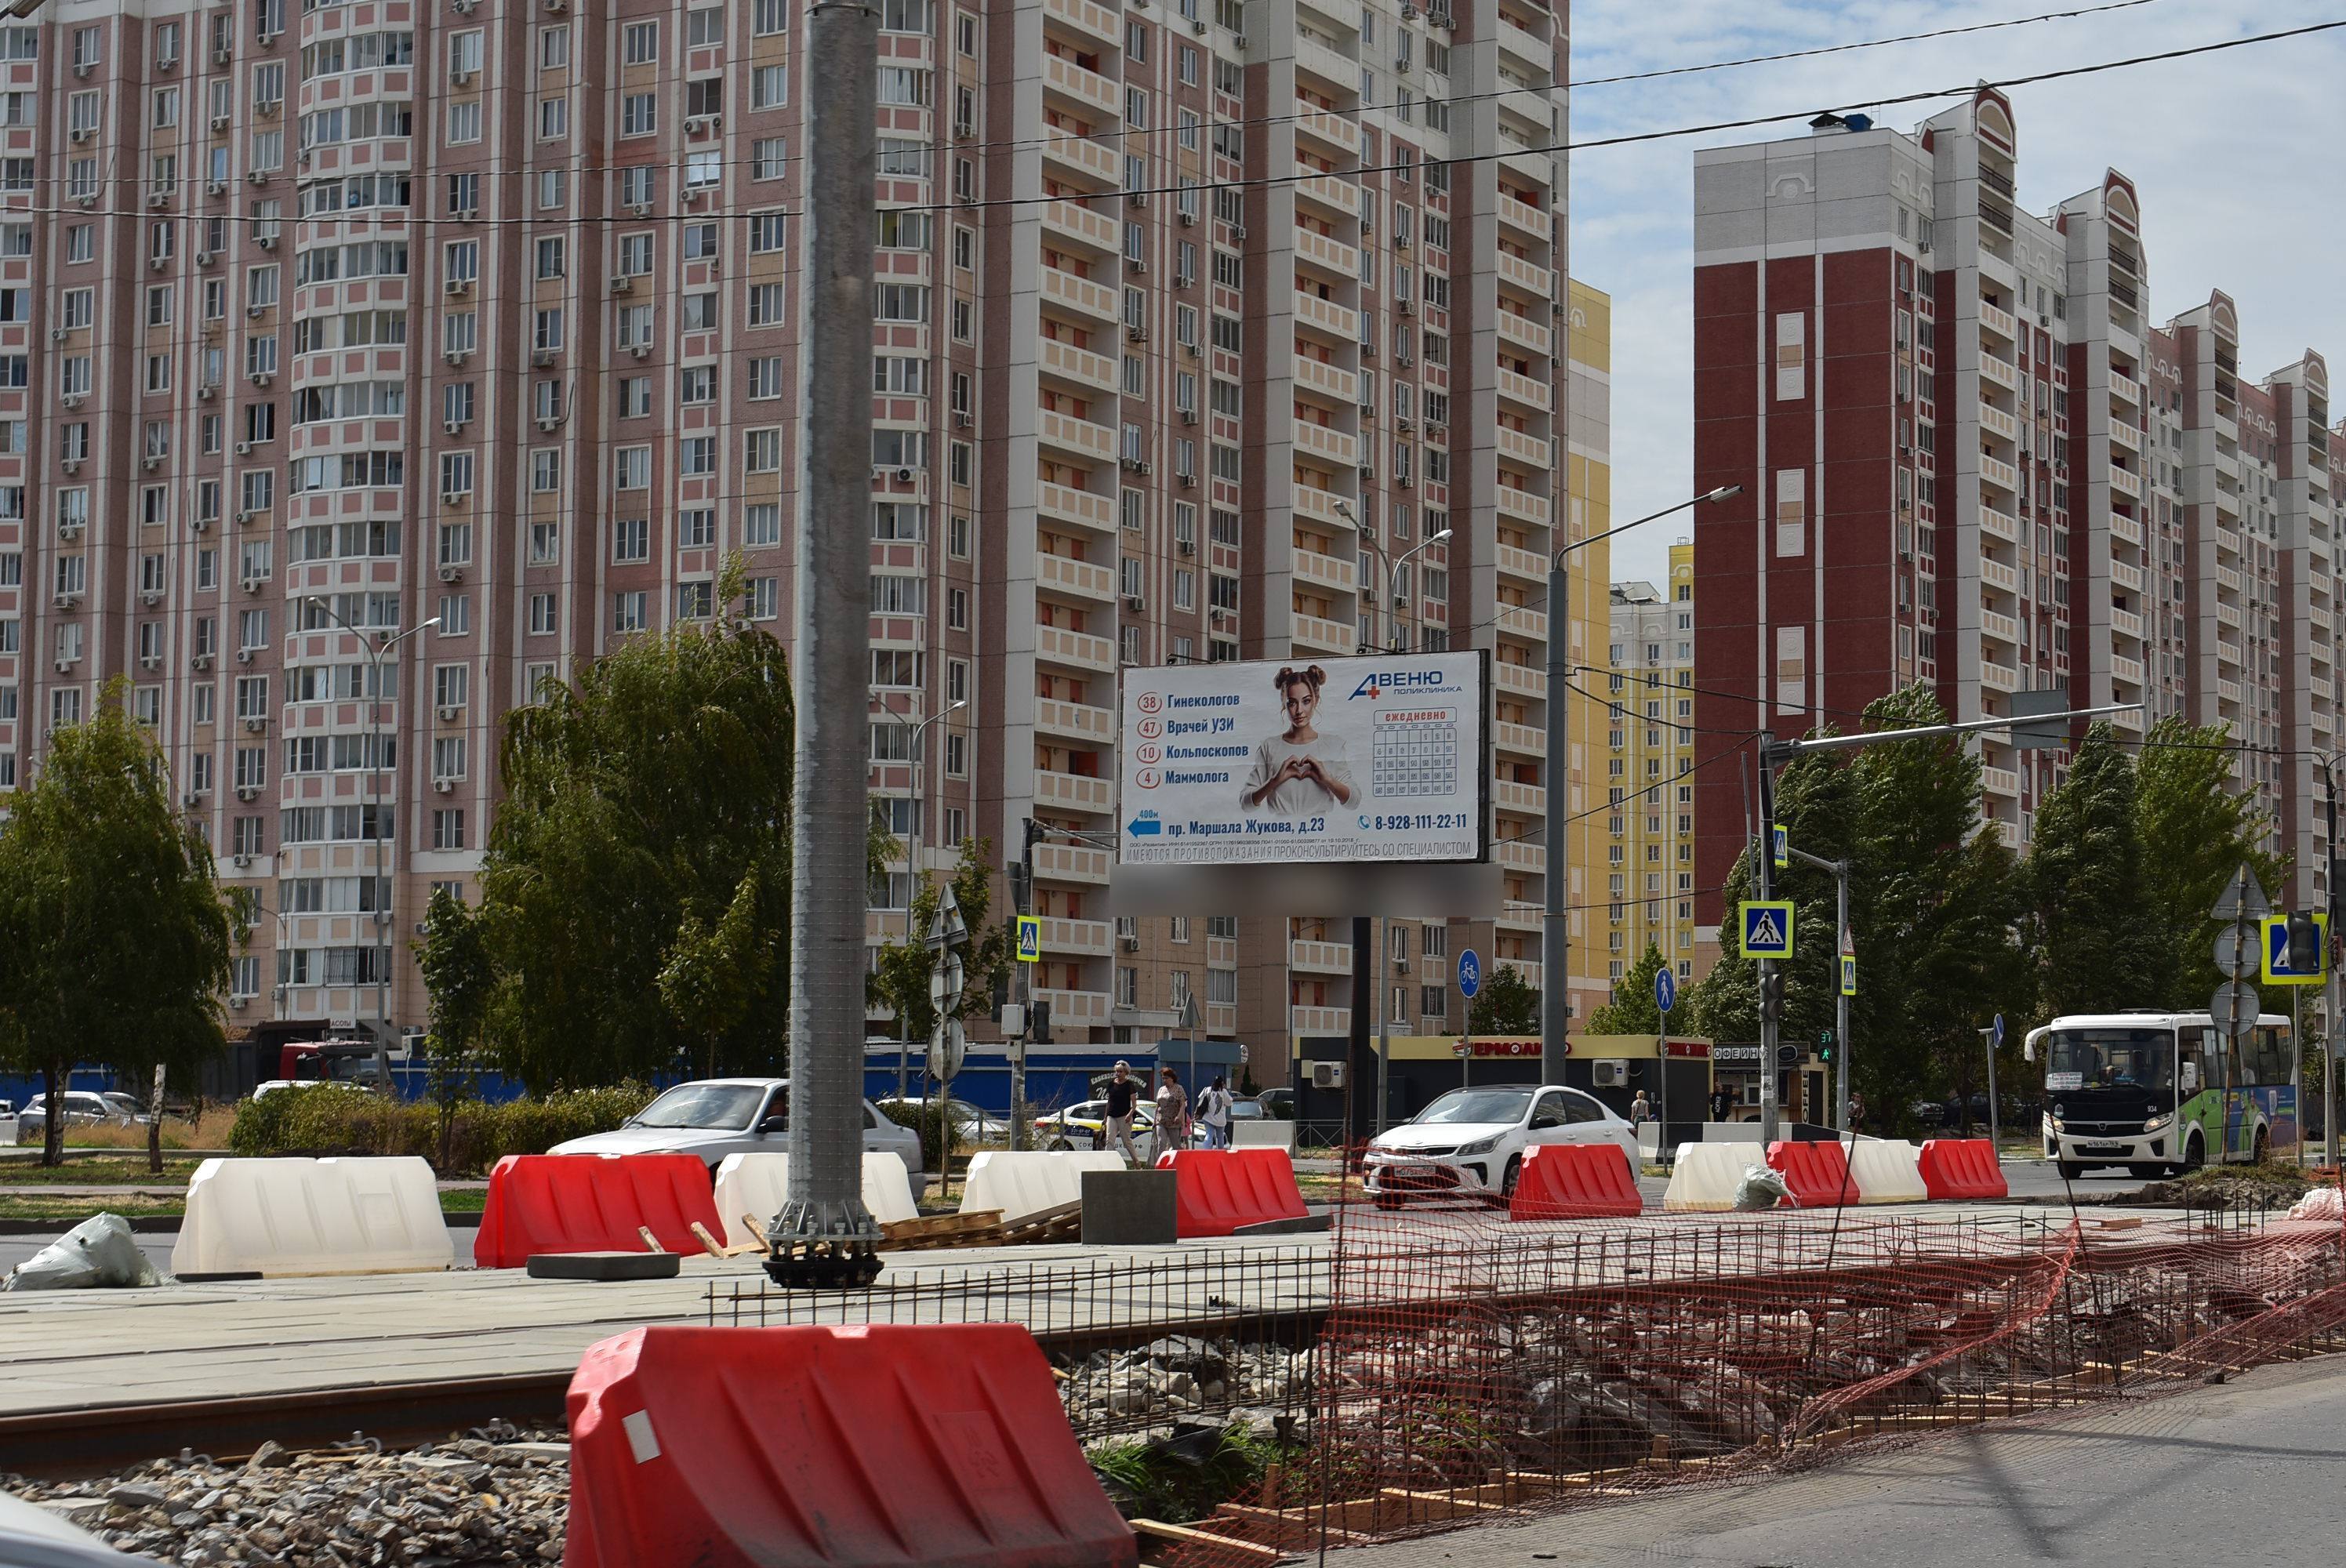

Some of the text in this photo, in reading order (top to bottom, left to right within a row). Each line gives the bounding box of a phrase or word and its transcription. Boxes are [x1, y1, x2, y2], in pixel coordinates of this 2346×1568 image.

[1348, 670, 1443, 701] АВЕНЮ
[1393, 686, 1462, 695] ПОЛИКЛИНИКА
[1143, 694, 1240, 709] 38 Гинекологов
[1385, 711, 1446, 723] ежедневно
[1143, 717, 1234, 736] 47 Врачей УЗИ
[1142, 746, 1249, 759] 10 Кольпоскопов
[1145, 771, 1229, 784] 4 Маммолога
[1139, 809, 1159, 818] 400м
[1168, 817, 1325, 837] пр. Маршала Жукова, д.23
[1375, 813, 1467, 830] 8-928-111-22-11
[1127, 841, 1471, 861] ИМЕЮТСЯ ПРОТИВОПОКАЗАНИЯ ПРОКОНСУЛЬТИРУЙТЕСЬ СО СПЕЦИАЛИСТОМ
[1714, 1048, 1762, 1058] ОФЕЙН
